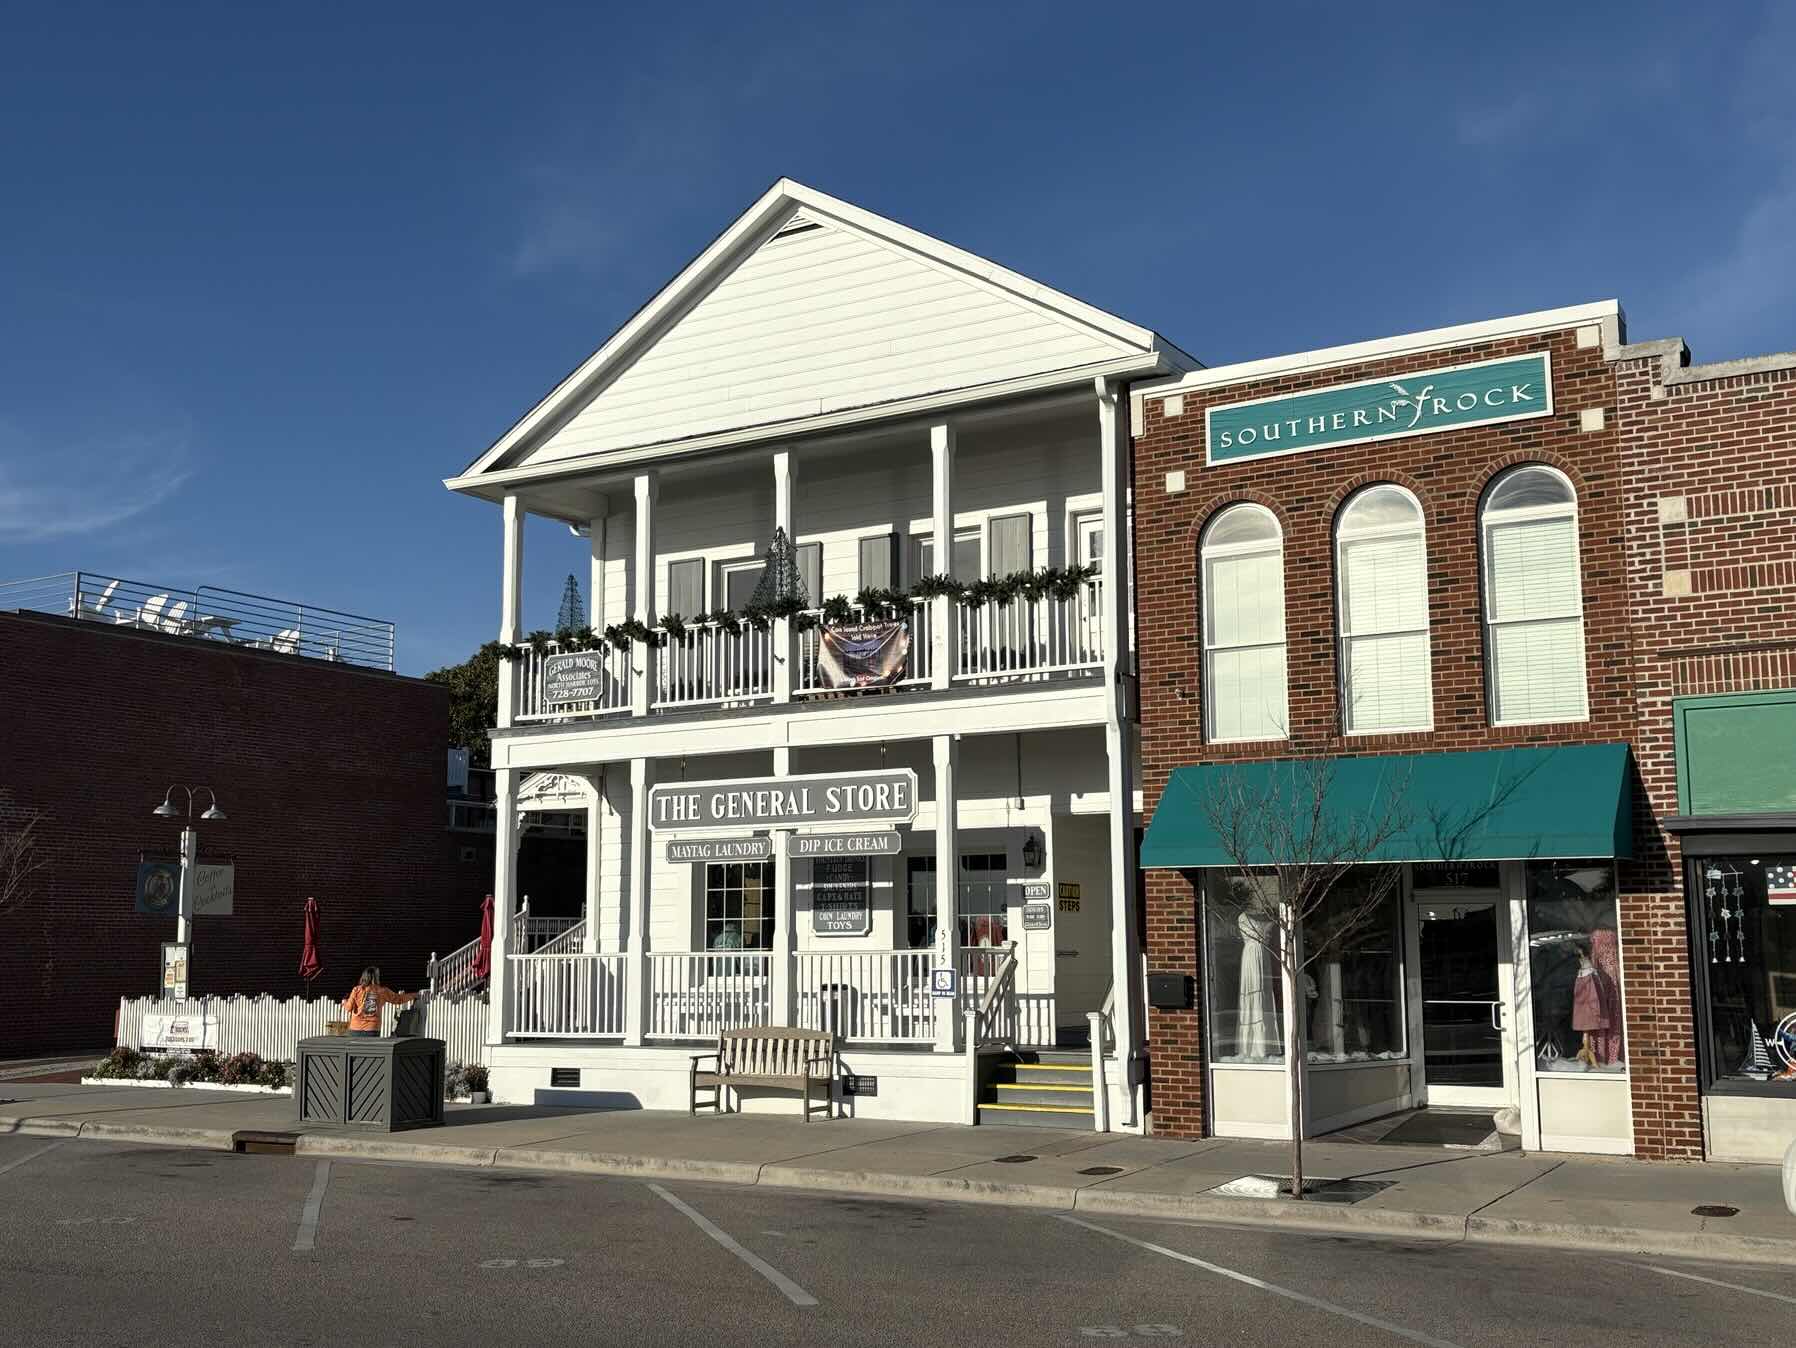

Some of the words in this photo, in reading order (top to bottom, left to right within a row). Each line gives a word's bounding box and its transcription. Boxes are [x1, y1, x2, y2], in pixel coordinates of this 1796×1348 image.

[1220, 404, 1397, 449] SOUTHERN
[576, 657, 598, 671] MOORE
[552, 686, 594, 698] 728-7707
[656, 794, 701, 822] THE
[711, 788, 816, 819] GENERAL
[825, 782, 908, 814] STORE
[671, 844, 712, 858] MAYTAG
[715, 842, 767, 857] LAUNDRY
[799, 838, 821, 853] DIP
[823, 838, 845, 852] ICE
[847, 836, 889, 851] CREAM
[1025, 885, 1047, 896] OPEN
[1058, 900, 1080, 912] STEPS
[819, 911, 833, 921] COIN
[836, 911, 863, 921] LAUNDRY
[827, 921, 853, 930] TOYS
[1765, 1038, 1775, 1047] W
